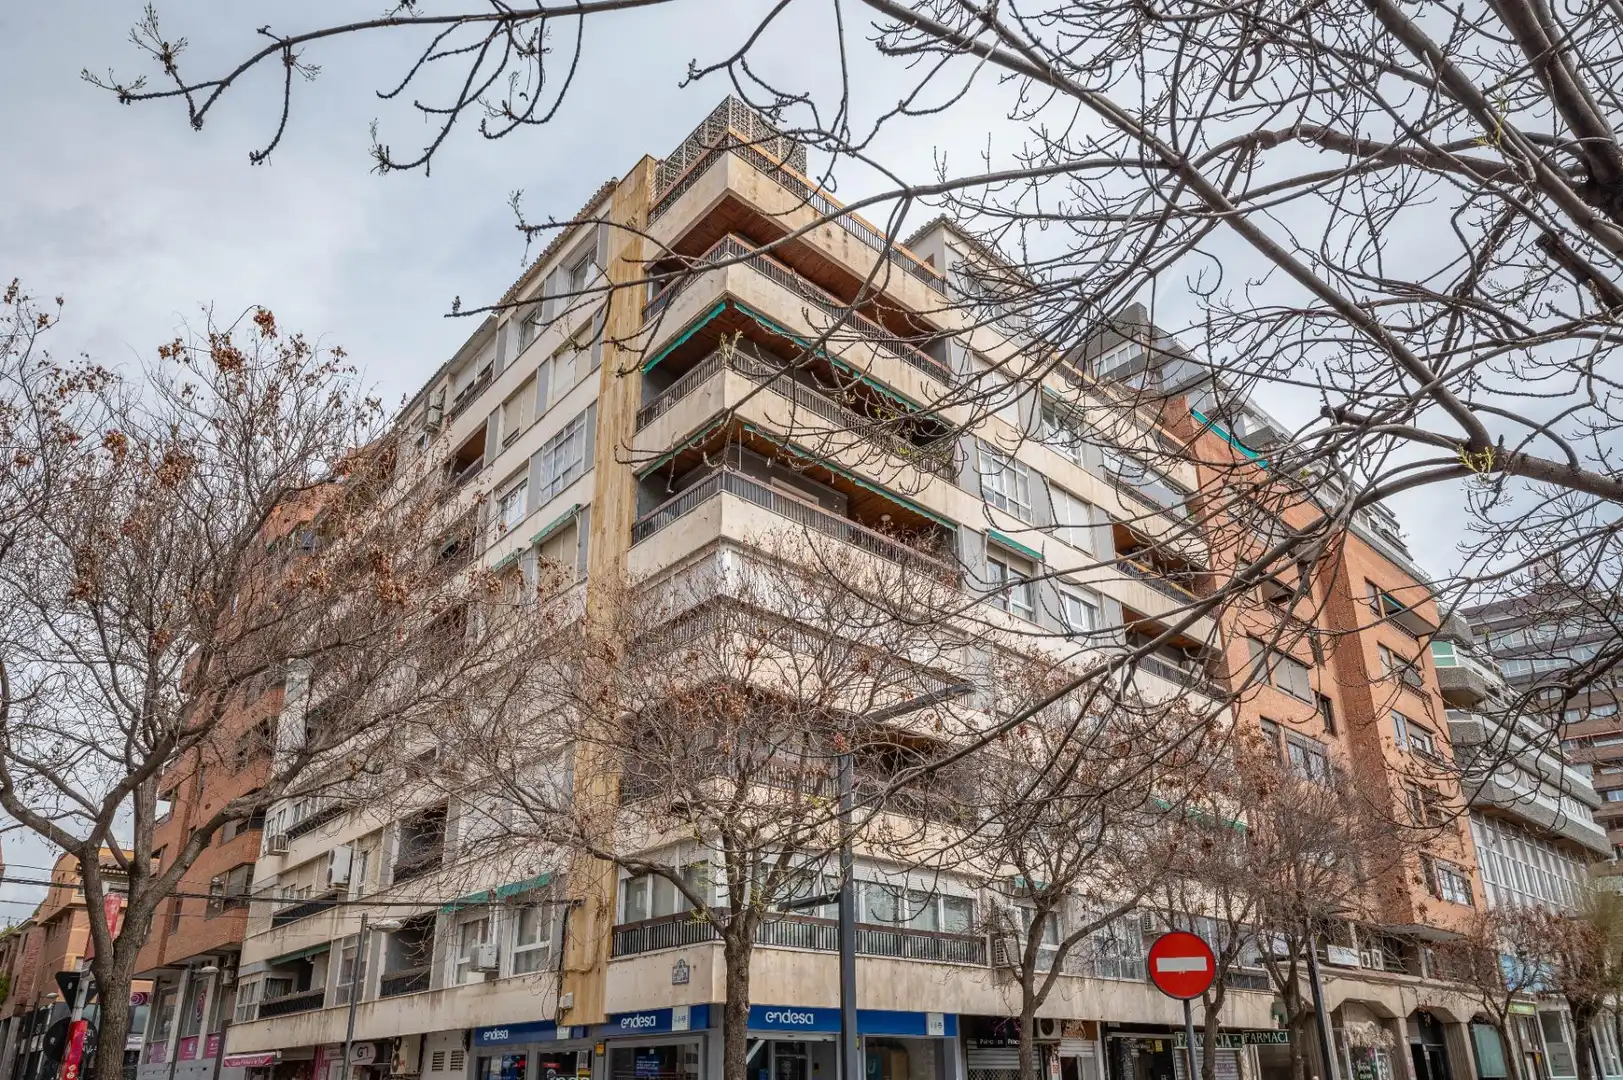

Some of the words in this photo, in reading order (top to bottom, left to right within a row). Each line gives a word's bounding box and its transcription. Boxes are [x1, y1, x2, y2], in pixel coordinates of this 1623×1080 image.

[620, 1014, 656, 1029] endesa
[765, 1009, 814, 1025] endesa
[483, 1028, 509, 1041] endesa
[1244, 1032, 1289, 1043] FARMACI
